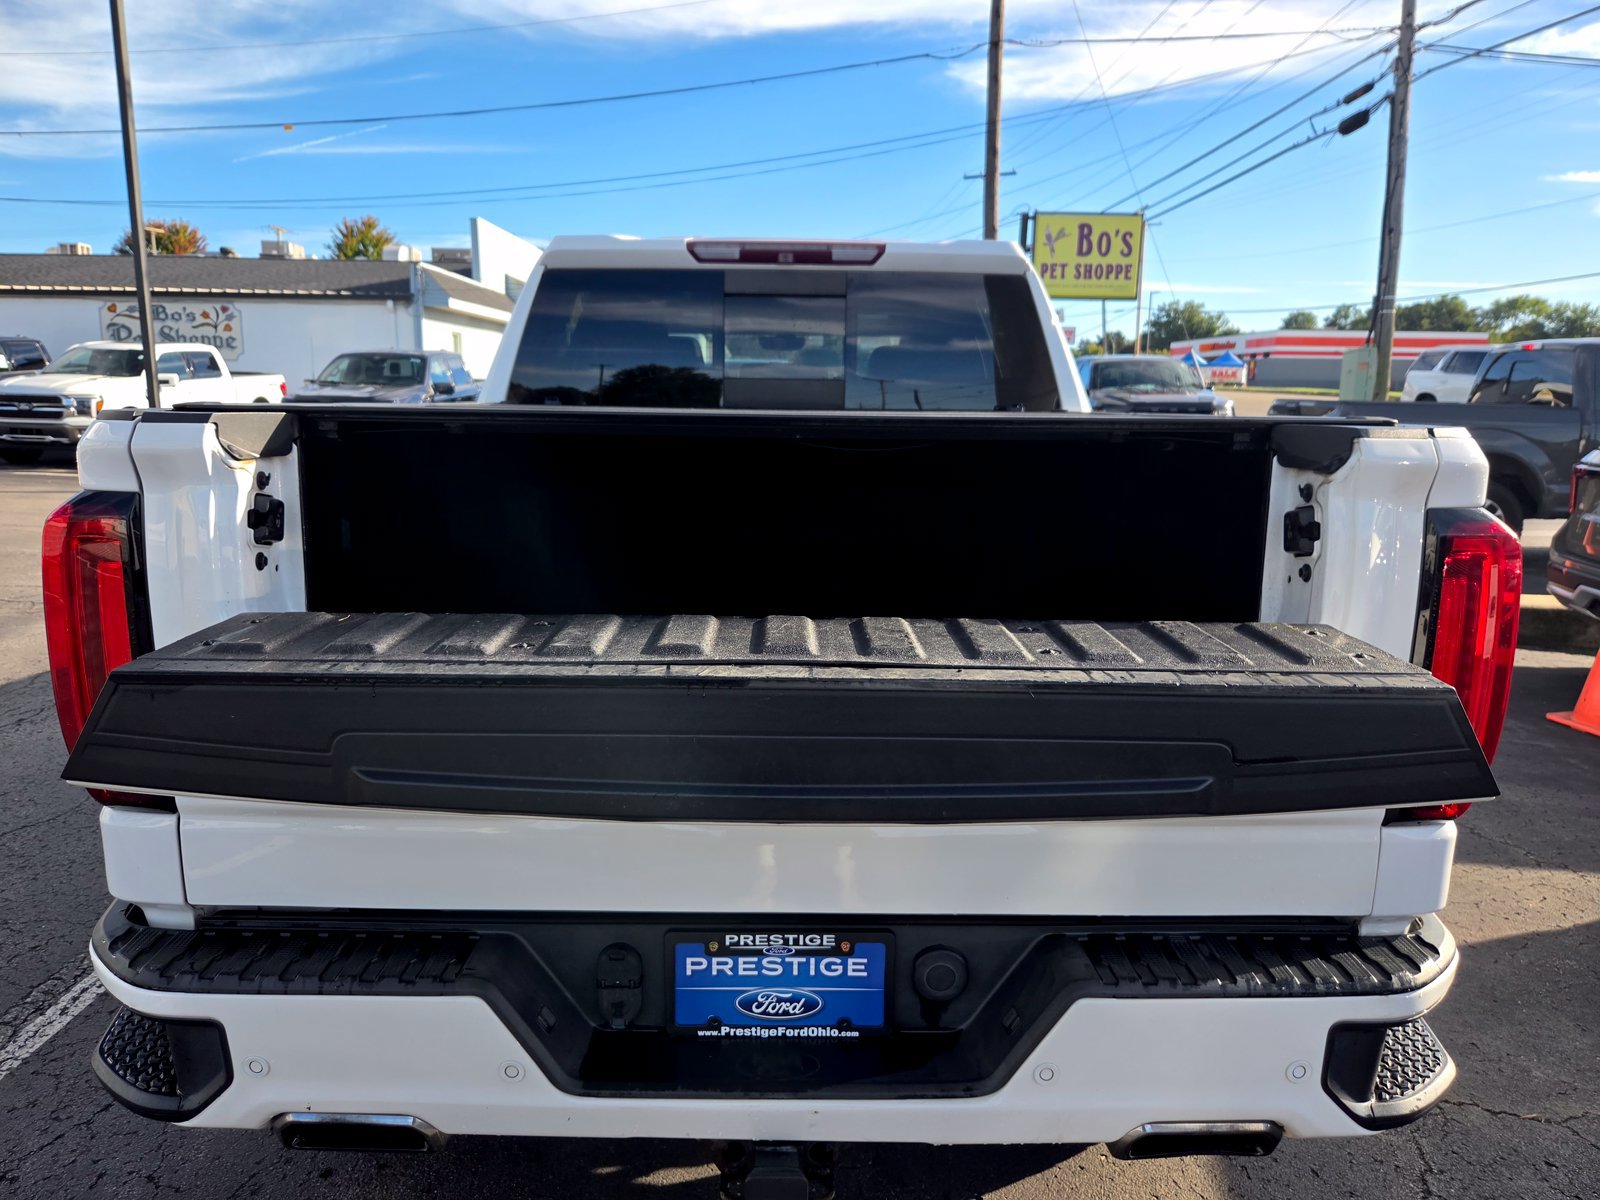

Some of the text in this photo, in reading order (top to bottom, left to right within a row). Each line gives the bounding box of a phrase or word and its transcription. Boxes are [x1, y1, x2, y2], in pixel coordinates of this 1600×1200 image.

[1040, 263, 1133, 280] PET SHOPPE
[151, 304, 197, 322] Bo's
[725, 934, 836, 946] PRESTIGE
[769, 946, 788, 954] Ford
[685, 957, 869, 977] PRESTIGE
[751, 991, 806, 1015] Ford
[697, 1026, 860, 1038] www.PrestigeFordOhio.com
